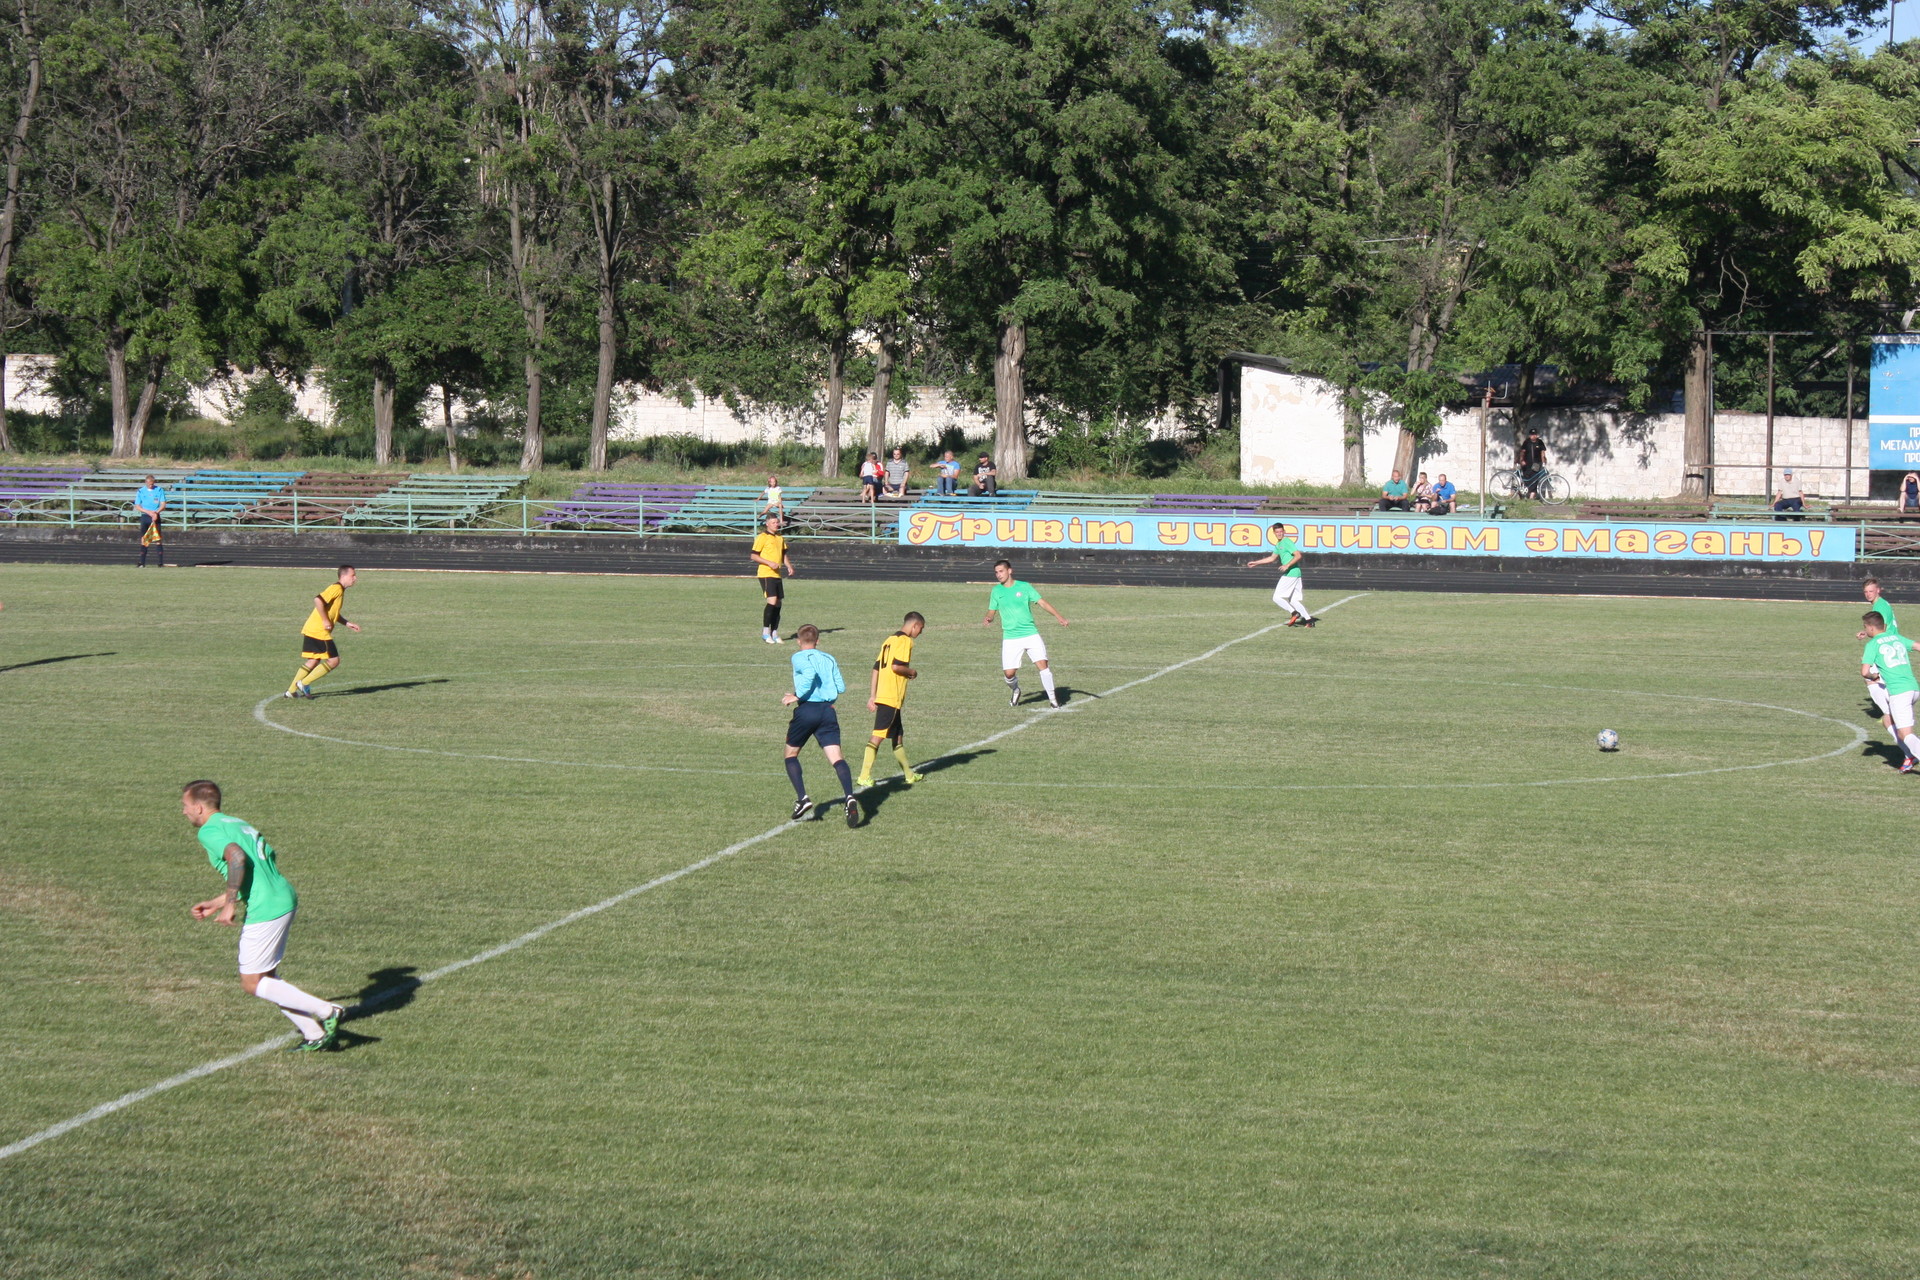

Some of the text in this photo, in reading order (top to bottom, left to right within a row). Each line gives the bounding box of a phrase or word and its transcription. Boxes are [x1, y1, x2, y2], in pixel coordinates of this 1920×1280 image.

[906, 511, 1826, 558] Привіт учасникам змагань!
[1878, 640, 1907, 669] 22
